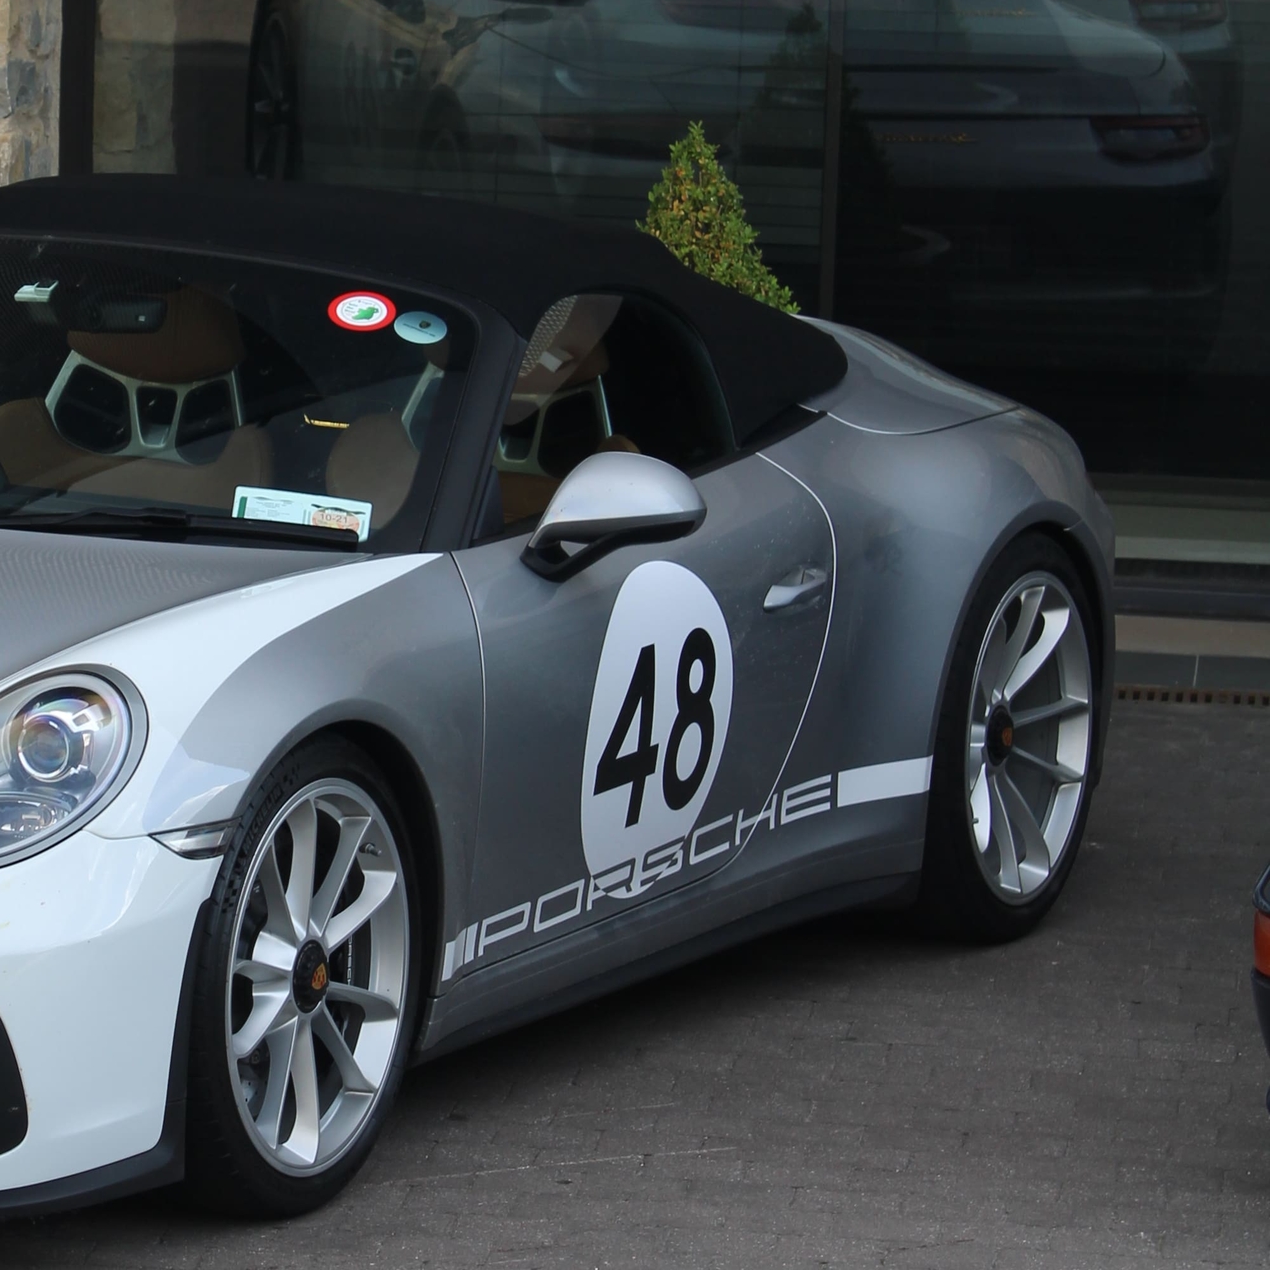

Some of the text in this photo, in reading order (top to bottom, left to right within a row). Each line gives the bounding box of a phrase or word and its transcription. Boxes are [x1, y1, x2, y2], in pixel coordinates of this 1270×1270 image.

[320, 512, 348, 524] 10-21
[593, 627, 716, 828] 48
[241, 784, 286, 854] MICHELIN
[478, 774, 832, 957] PORSCHE
